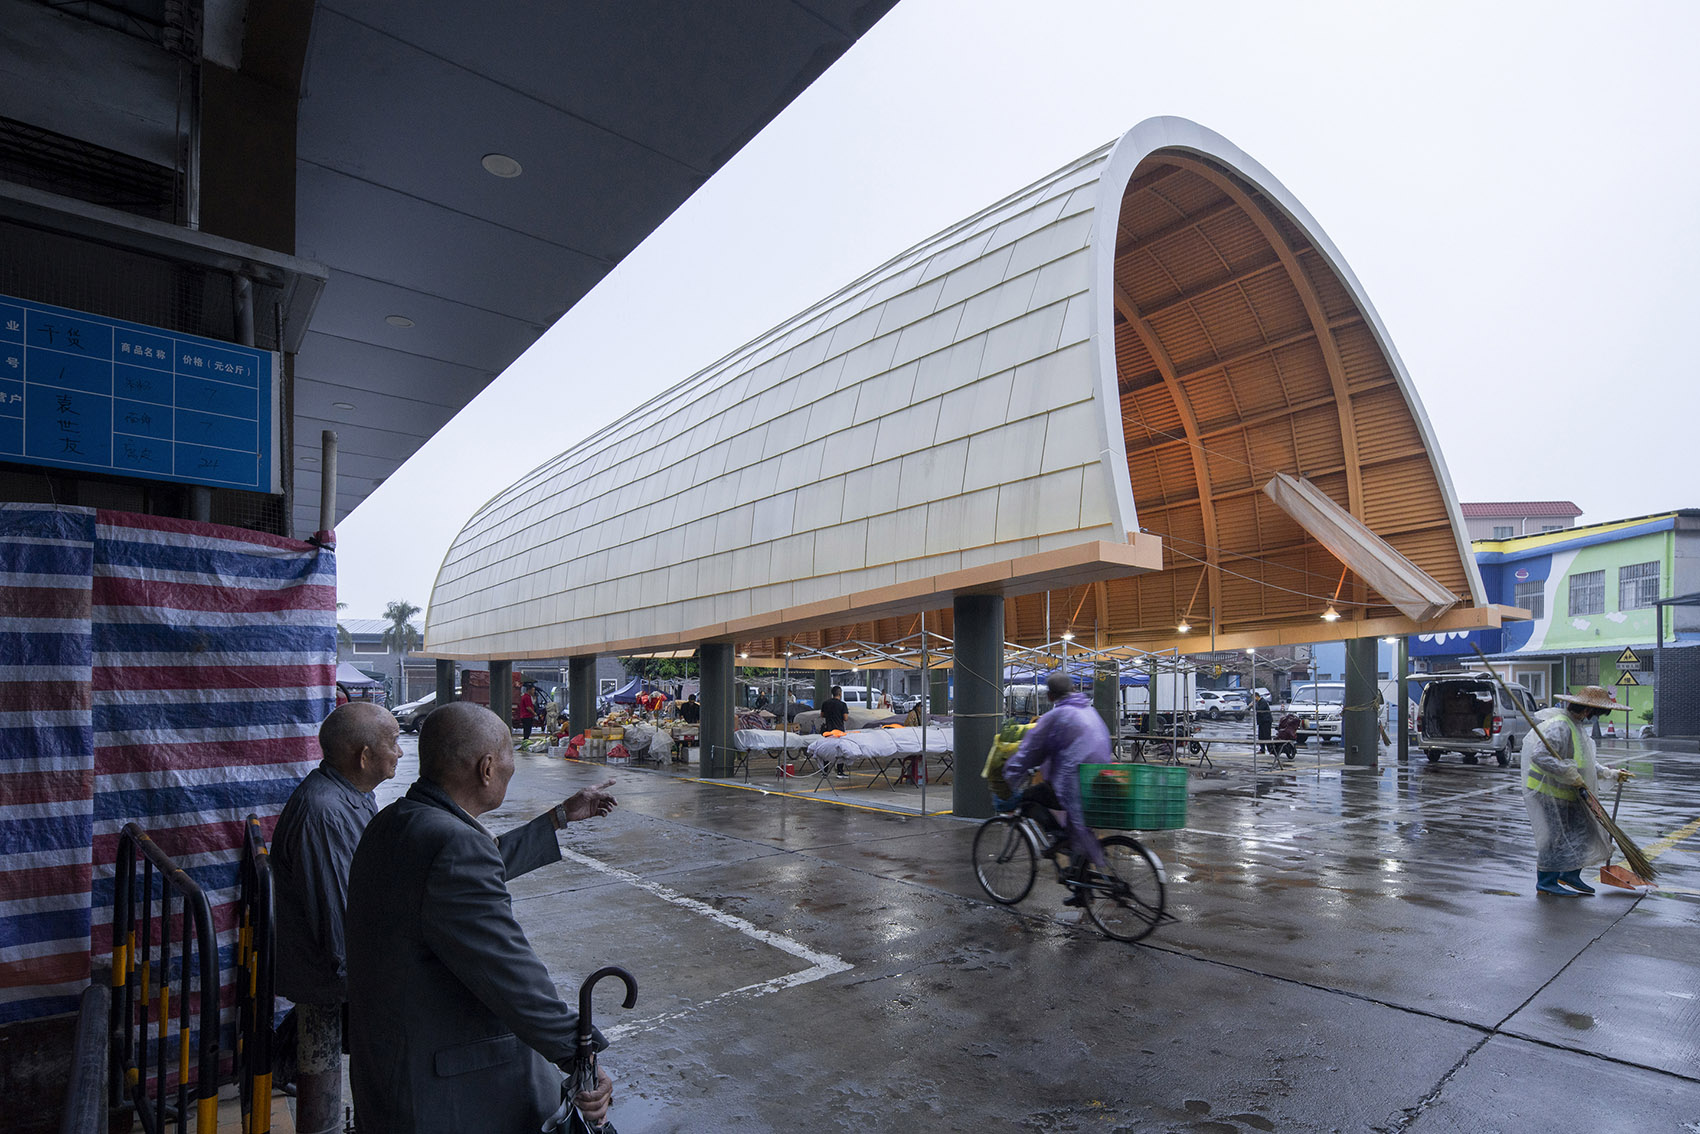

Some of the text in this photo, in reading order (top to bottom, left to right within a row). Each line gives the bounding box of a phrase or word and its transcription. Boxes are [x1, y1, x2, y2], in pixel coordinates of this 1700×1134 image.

[5, 320, 20, 332] 业
[37, 324, 85, 350] 干货
[121, 342, 166, 360] 商品名称
[5, 356, 20, 369] 号
